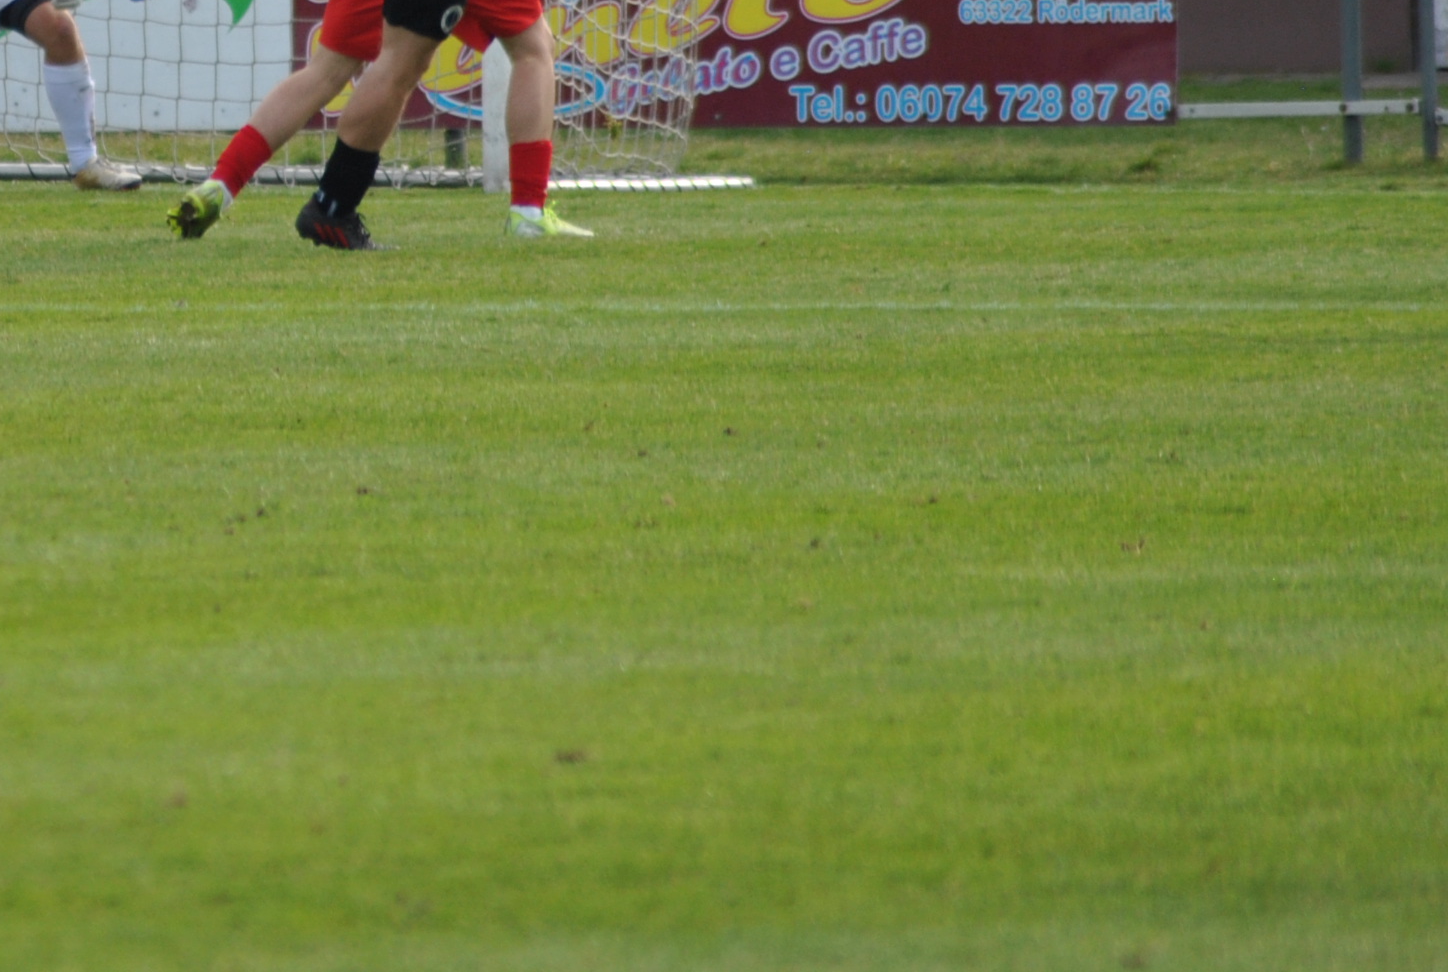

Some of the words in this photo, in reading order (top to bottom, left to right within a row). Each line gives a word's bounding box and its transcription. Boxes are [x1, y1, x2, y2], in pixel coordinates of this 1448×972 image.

[770, 46, 800, 81] e
[807, 17, 927, 74] Caffe
[788, 84, 867, 123] Tel.:
[875, 83, 987, 123] 06074
[996, 83, 1063, 122] 728
[1070, 83, 1118, 122] 87
[1124, 82, 1171, 121] 26
